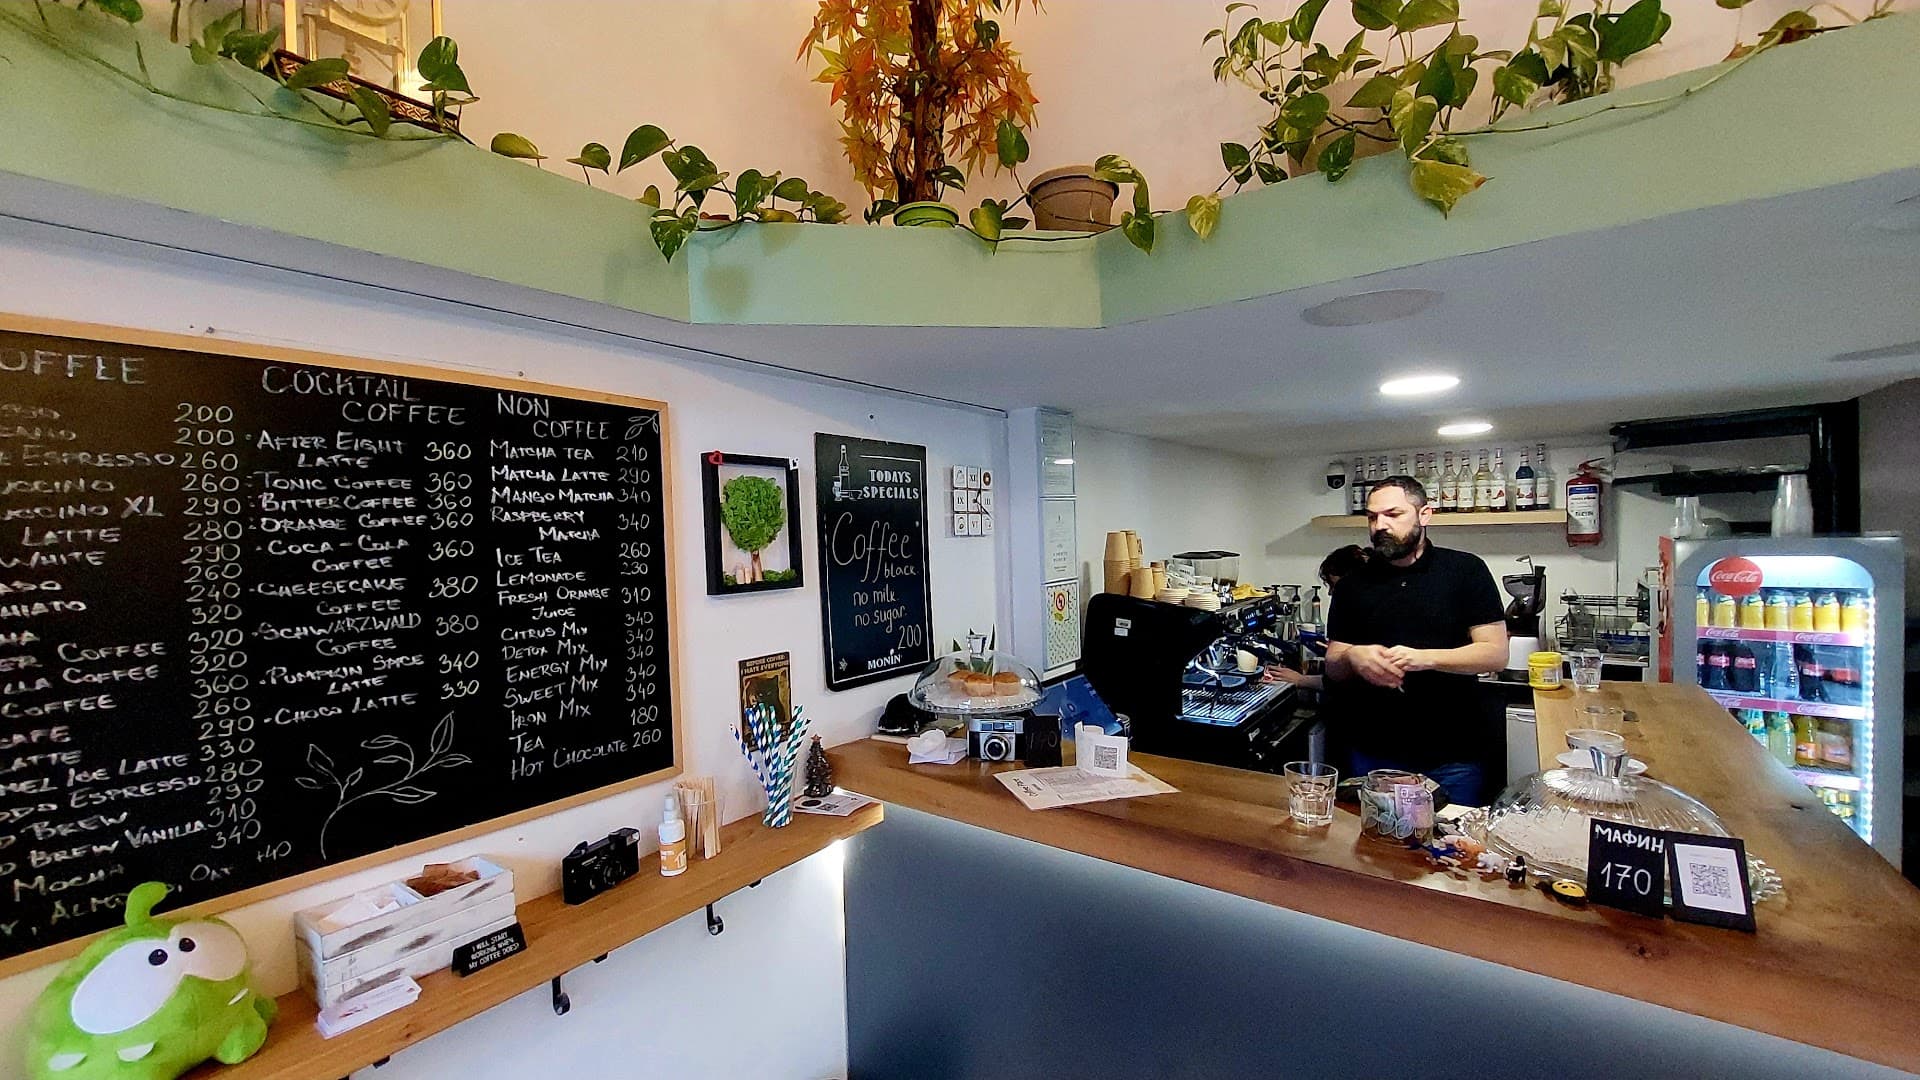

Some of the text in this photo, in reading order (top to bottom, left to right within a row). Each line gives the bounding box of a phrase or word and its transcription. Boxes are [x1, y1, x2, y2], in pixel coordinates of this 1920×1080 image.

[0, 349, 145, 385] OFFEE
[263, 366, 420, 402] COCKTAIL
[173, 402, 233, 424] 200
[342, 401, 466, 426] COFFEE
[497, 392, 549, 418] NON
[174, 427, 235, 447] 200
[533, 420, 611, 440] COFFEE
[22, 444, 175, 467] ESPRESSO
[180, 451, 239, 472] 260
[257, 430, 472, 462] AFTER EIGHT 360
[490, 439, 648, 463] MATCHA TEA 210
[298, 453, 374, 470] LATTE
[181, 473, 240, 493] 260
[254, 471, 473, 493] TONIC COFFEE 360
[491, 465, 651, 485] MATCHA LATTE 290
[260, 492, 472, 513] BITTER COFFEE 360
[491, 486, 651, 504] MANGO MATCHA 340
[862, 486, 919, 500] SPECIALS
[121, 495, 164, 519] XL
[183, 497, 241, 516] 290
[490, 505, 650, 531] RASPBERRY 340
[22, 520, 243, 546] LATTE 280
[260, 512, 474, 534] ORANGE COFFEE 360
[539, 526, 601, 542] MATCHA
[181, 543, 240, 564] 290
[268, 534, 475, 562] COCA COLA 360
[496, 542, 651, 568] ICE TEA 260
[832, 511, 913, 583] Coffee
[184, 562, 242, 584] 260
[312, 556, 393, 573] COFFEE
[496, 561, 649, 587] LEMONADE 230
[186, 582, 241, 603] 240
[257, 575, 479, 598] CHEESECAKE 380
[498, 585, 651, 606] FRESH ORANGE 310
[853, 591, 869, 607] no
[191, 603, 242, 625] 320
[316, 600, 402, 615] COFFEE
[531, 606, 576, 620] JUICE
[854, 613, 870, 628] no
[258, 612, 480, 641] SCHWARZWALD 380
[501, 611, 654, 641] CITRUS MIX 340
[897, 623, 922, 650] 200
[57, 628, 243, 663] COFFEE 320
[316, 638, 398, 657] COFFEE
[502, 628, 654, 660] DETOX MIX 340
[265, 650, 480, 685] PUMPKIN SPICE 340
[506, 645, 654, 684] ENERGY MIX 340
[867, 648, 902, 670] MONIN
[3, 650, 248, 695] LLA COFFEE 320
[327, 675, 388, 695] LATTE
[1, 674, 249, 718] COFFEE 360
[503, 663, 656, 709] SWEET MIX 340
[192, 697, 251, 719] 260
[275, 679, 480, 726] CHOCO LATTE 330
[511, 682, 656, 731] IRON MIX 340
[198, 715, 254, 740] 290
[509, 705, 658, 754] TEA 180
[119, 753, 191, 776] LATTE
[200, 738, 255, 761] 330
[511, 728, 662, 781] HOT CHOCOLATE 260
[70, 775, 202, 809] ESPRESSO
[204, 759, 263, 783] 280
[20, 811, 128, 841] BREW
[206, 778, 264, 805] 290
[28, 839, 120, 869] BREW
[124, 819, 207, 849] VANILLA
[208, 798, 256, 828] 310
[1594, 823, 1665, 853] МАФИН
[13, 818, 262, 902] MOCHA 340
[1600, 861, 1652, 896] 170
